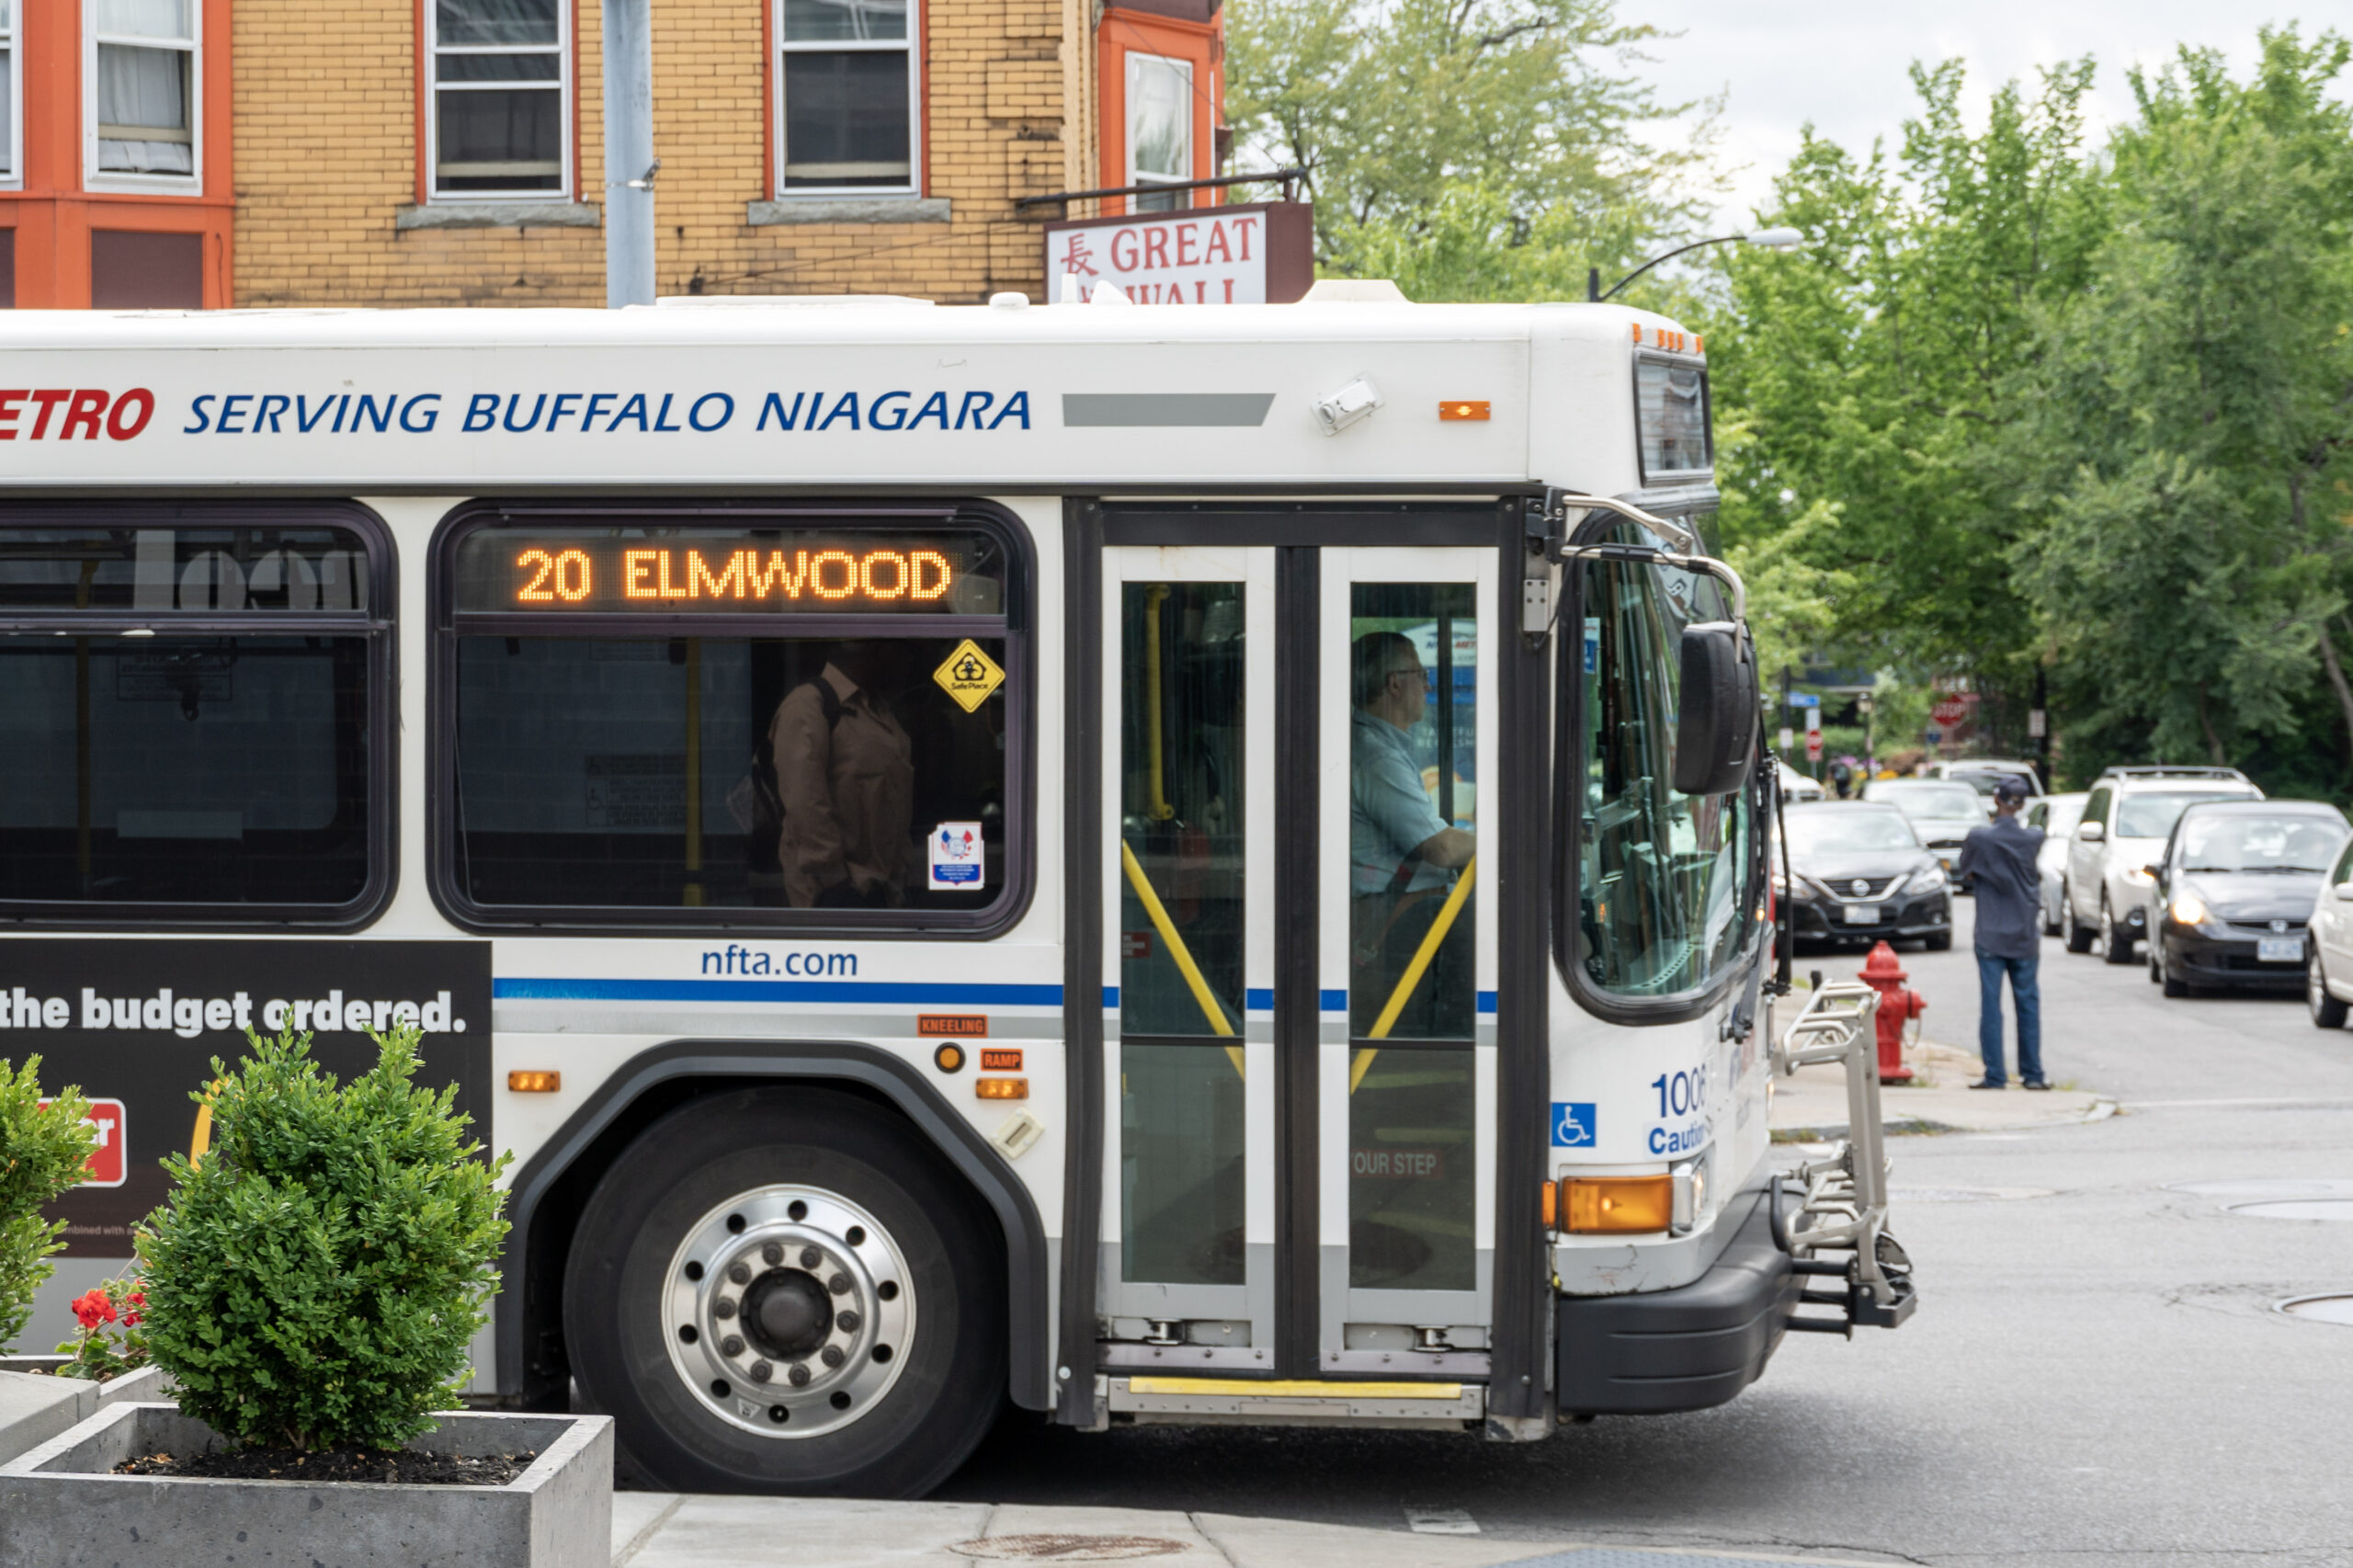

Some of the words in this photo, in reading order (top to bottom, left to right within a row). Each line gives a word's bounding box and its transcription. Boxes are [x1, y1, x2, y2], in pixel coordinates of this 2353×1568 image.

[1110, 217, 1257, 272] GREAT
[0, 387, 154, 442] ETRO
[183, 392, 442, 435] SERVING
[461, 392, 734, 433] BUFFALO
[756, 391, 1032, 431] NIAGARA
[516, 549, 591, 602] 20
[624, 550, 951, 600] ELMWOOD
[1934, 701, 1966, 718] STOP
[702, 944, 858, 976] nfta.com
[0, 986, 70, 1028] the
[82, 987, 253, 1039] budget
[263, 989, 466, 1033] ordered.
[921, 1018, 983, 1033] KNEELING
[983, 1053, 1020, 1068] RAMP
[1351, 1152, 1390, 1175] OUR
[1393, 1152, 1438, 1175] STEP
[104, 1225, 125, 1235] with
